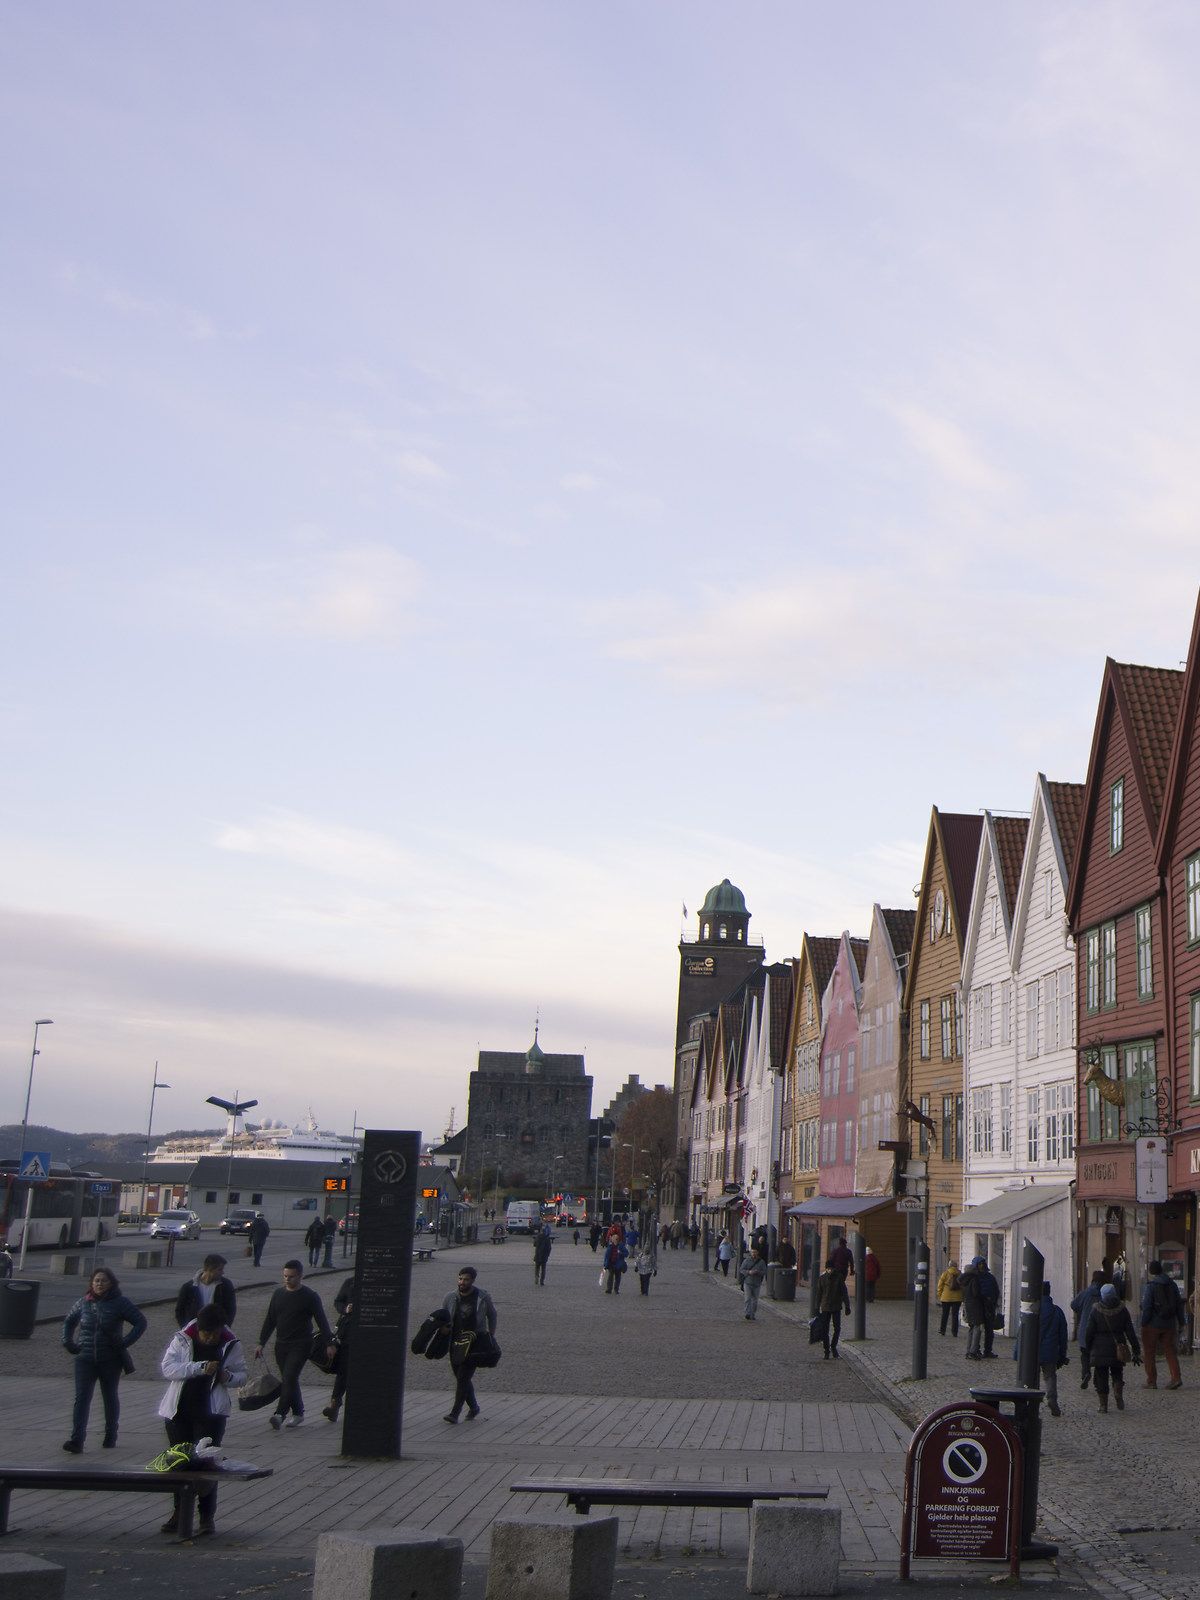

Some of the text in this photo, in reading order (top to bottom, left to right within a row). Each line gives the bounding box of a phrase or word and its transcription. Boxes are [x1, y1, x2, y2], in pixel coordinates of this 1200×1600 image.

[1083, 1161, 1118, 1181] BRYGGEN
[941, 1486, 986, 1495] INNKJØRING
[925, 1504, 1000, 1513] PARKERING FORBUDT
[927, 1513, 997, 1523] Gjelder hele plassen
